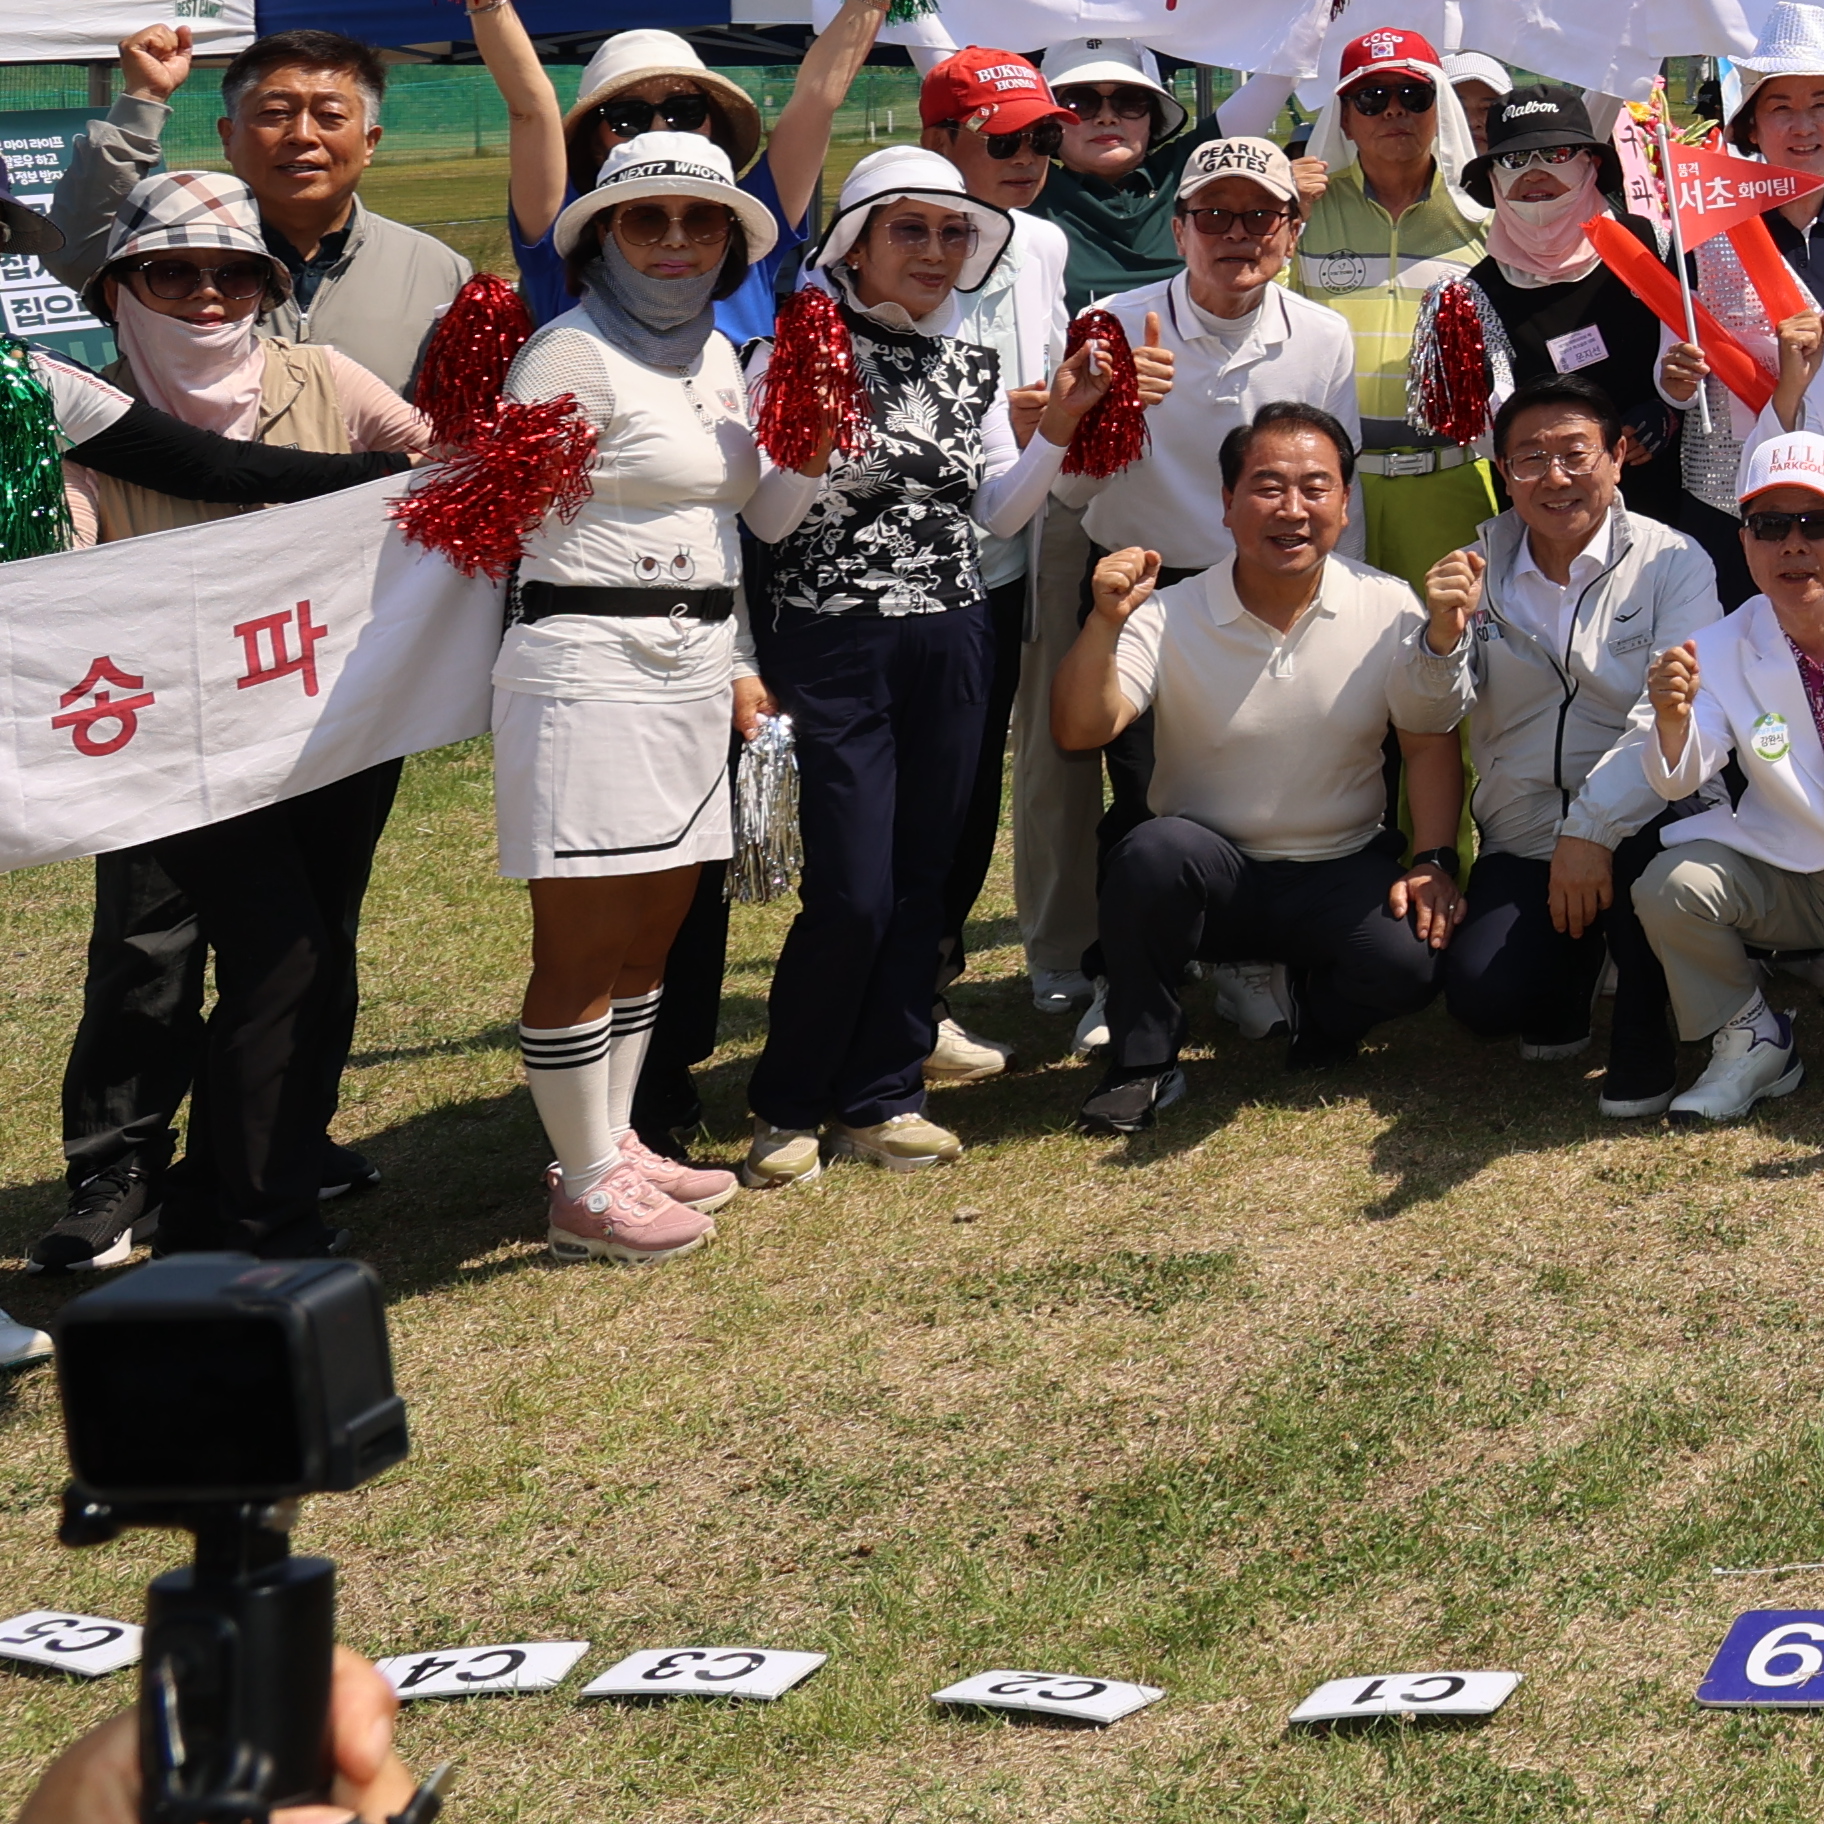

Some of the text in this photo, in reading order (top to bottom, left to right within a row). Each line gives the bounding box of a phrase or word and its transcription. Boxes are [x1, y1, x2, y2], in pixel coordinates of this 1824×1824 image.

[1501, 100, 1560, 123] Malbon
[3, 136, 65, 150] 마이 라이프
[1199, 142, 1273, 164] PEARLY
[35, 153, 60, 165] 하고
[1203, 155, 1268, 174] GATES
[1677, 161, 1699, 177] 풍격
[14, 170, 40, 186] 정보
[619, 162, 667, 181] NEXT?
[1678, 176, 1797, 215] 서초 화이팅!
[51, 599, 328, 758] 송파
[0, 1618, 125, 1652] C5
[400, 1648, 527, 1689] C4
[642, 1651, 767, 1682] C3
[988, 1672, 1109, 1703] C2
[1354, 1672, 1467, 1705] C1
